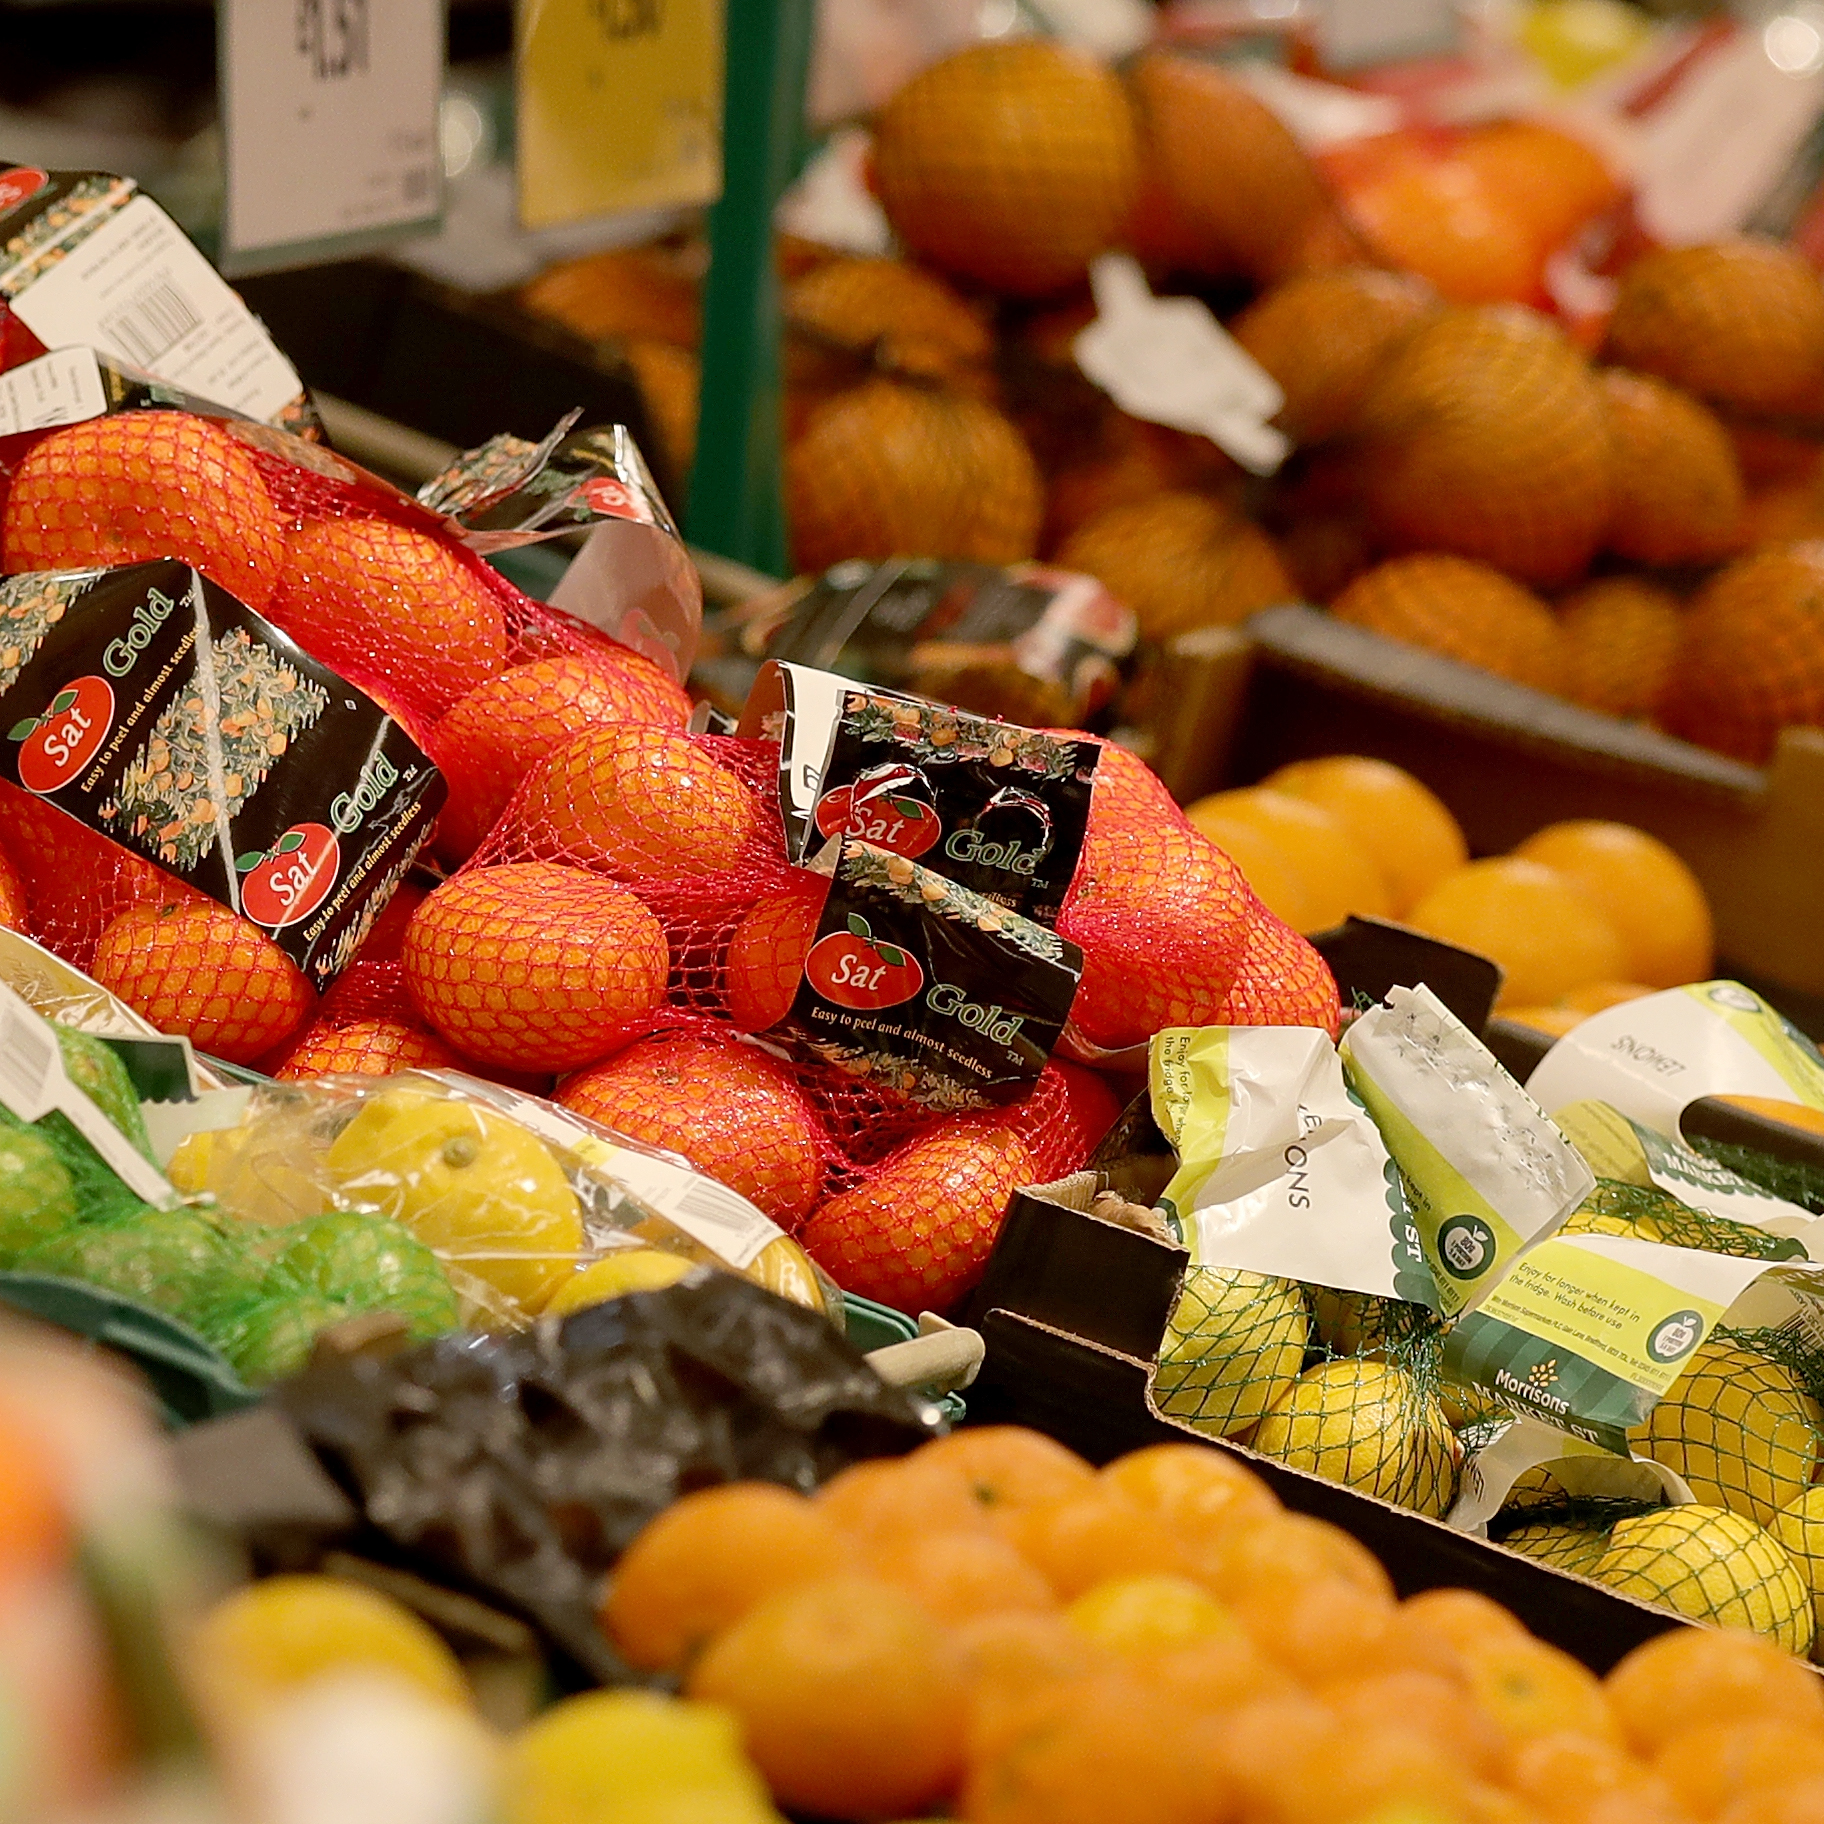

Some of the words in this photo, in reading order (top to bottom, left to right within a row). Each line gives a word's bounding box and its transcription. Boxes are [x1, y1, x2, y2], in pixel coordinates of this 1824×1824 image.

[103, 587, 175, 679] Gold
[43, 706, 93, 768] Sat
[81, 765, 105, 793] Easy
[99, 751, 113, 765] to
[109, 725, 130, 753] peel
[127, 701, 146, 727] and
[143, 664, 174, 704] almost
[170, 623, 204, 665] seedless
[331, 750, 399, 834] Gold
[845, 806, 906, 845] Sat
[268, 850, 319, 908] Sat
[303, 917, 326, 941] Easy
[321, 906, 335, 922] to
[332, 883, 351, 912] peel
[349, 866, 367, 889] and
[364, 836, 393, 870] almost
[390, 801, 422, 840] seedless
[945, 828, 1043, 875] Gold
[1031, 878, 1049, 889] TM
[831, 953, 886, 990] Sat
[811, 1007, 837, 1025] Easy
[840, 1013, 851, 1025] to
[853, 1017, 877, 1032] peel
[878, 1022, 902, 1037] and
[904, 1029, 944, 1053] almost
[948, 1045, 993, 1079] seedless
[926, 983, 1024, 1046] Gold
[1006, 1050, 1025, 1066] TM
[1164, 1037, 1174, 1055] the
[1177, 1037, 1191, 1070] Enjoy
[1180, 1071, 1191, 1086] for
[1609, 1034, 1687, 1077] LEMONS
[1284, 1103, 1323, 1210] EONS
[1509, 1273, 1523, 1286] the
[1524, 1279, 1551, 1299] fridge.
[1554, 1291, 1577, 1310] Wash
[1576, 1302, 1605, 1322] before
[1605, 1317, 1623, 1330] use
[1519, 1262, 1541, 1280] Enjoy
[1542, 1270, 1556, 1283] for
[1556, 1275, 1585, 1298] longer
[1585, 1289, 1608, 1307] when
[1608, 1300, 1631, 1318] kept
[1631, 1309, 1640, 1322] in
[1495, 1368, 1570, 1415] Morrisons
[1570, 1424, 1599, 1443] ST
